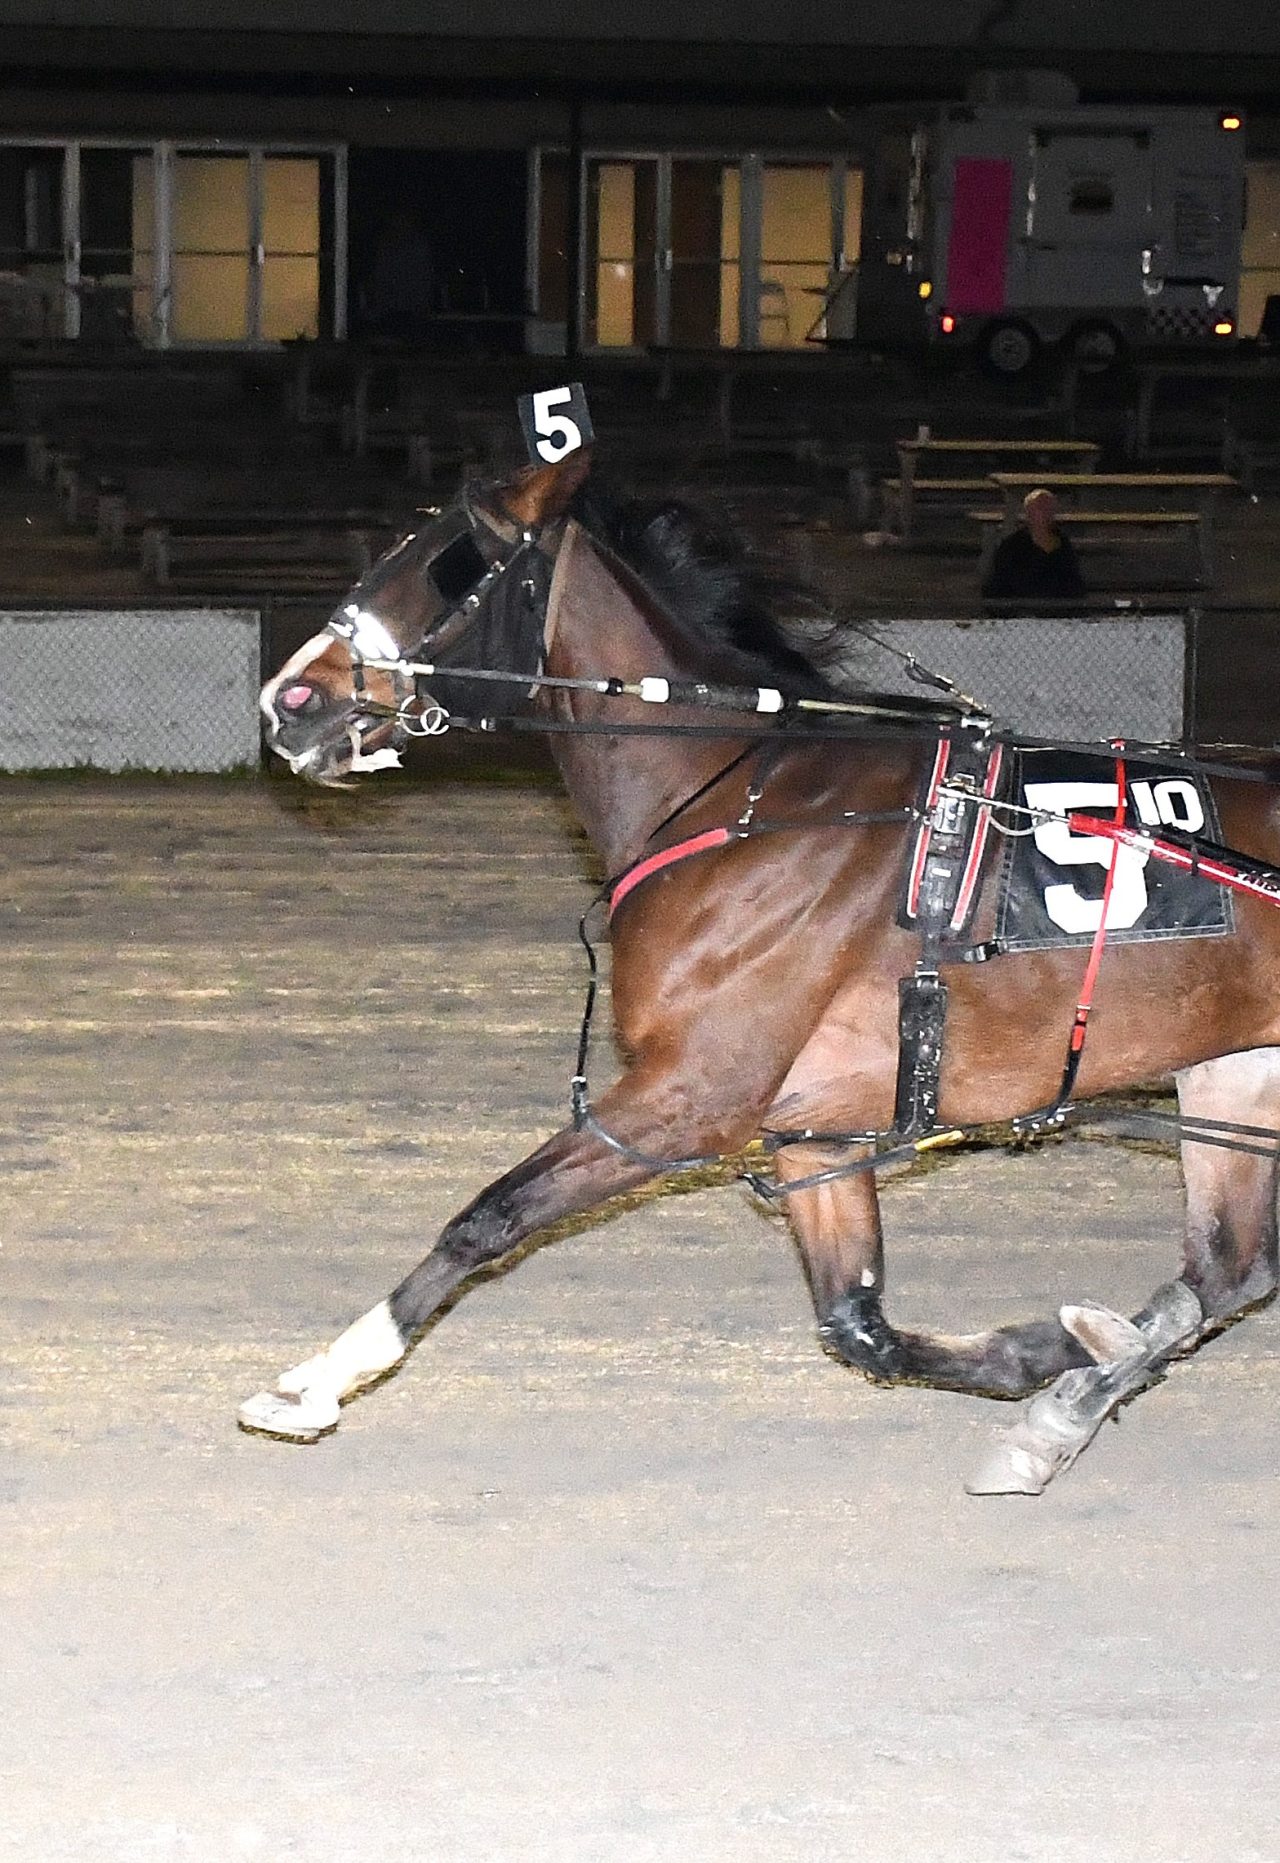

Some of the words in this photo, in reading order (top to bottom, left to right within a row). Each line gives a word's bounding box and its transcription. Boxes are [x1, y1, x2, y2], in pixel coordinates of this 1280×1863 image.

[533, 386, 582, 464] 5
[1130, 779, 1205, 834] 10
[1023, 782, 1151, 935] 5
